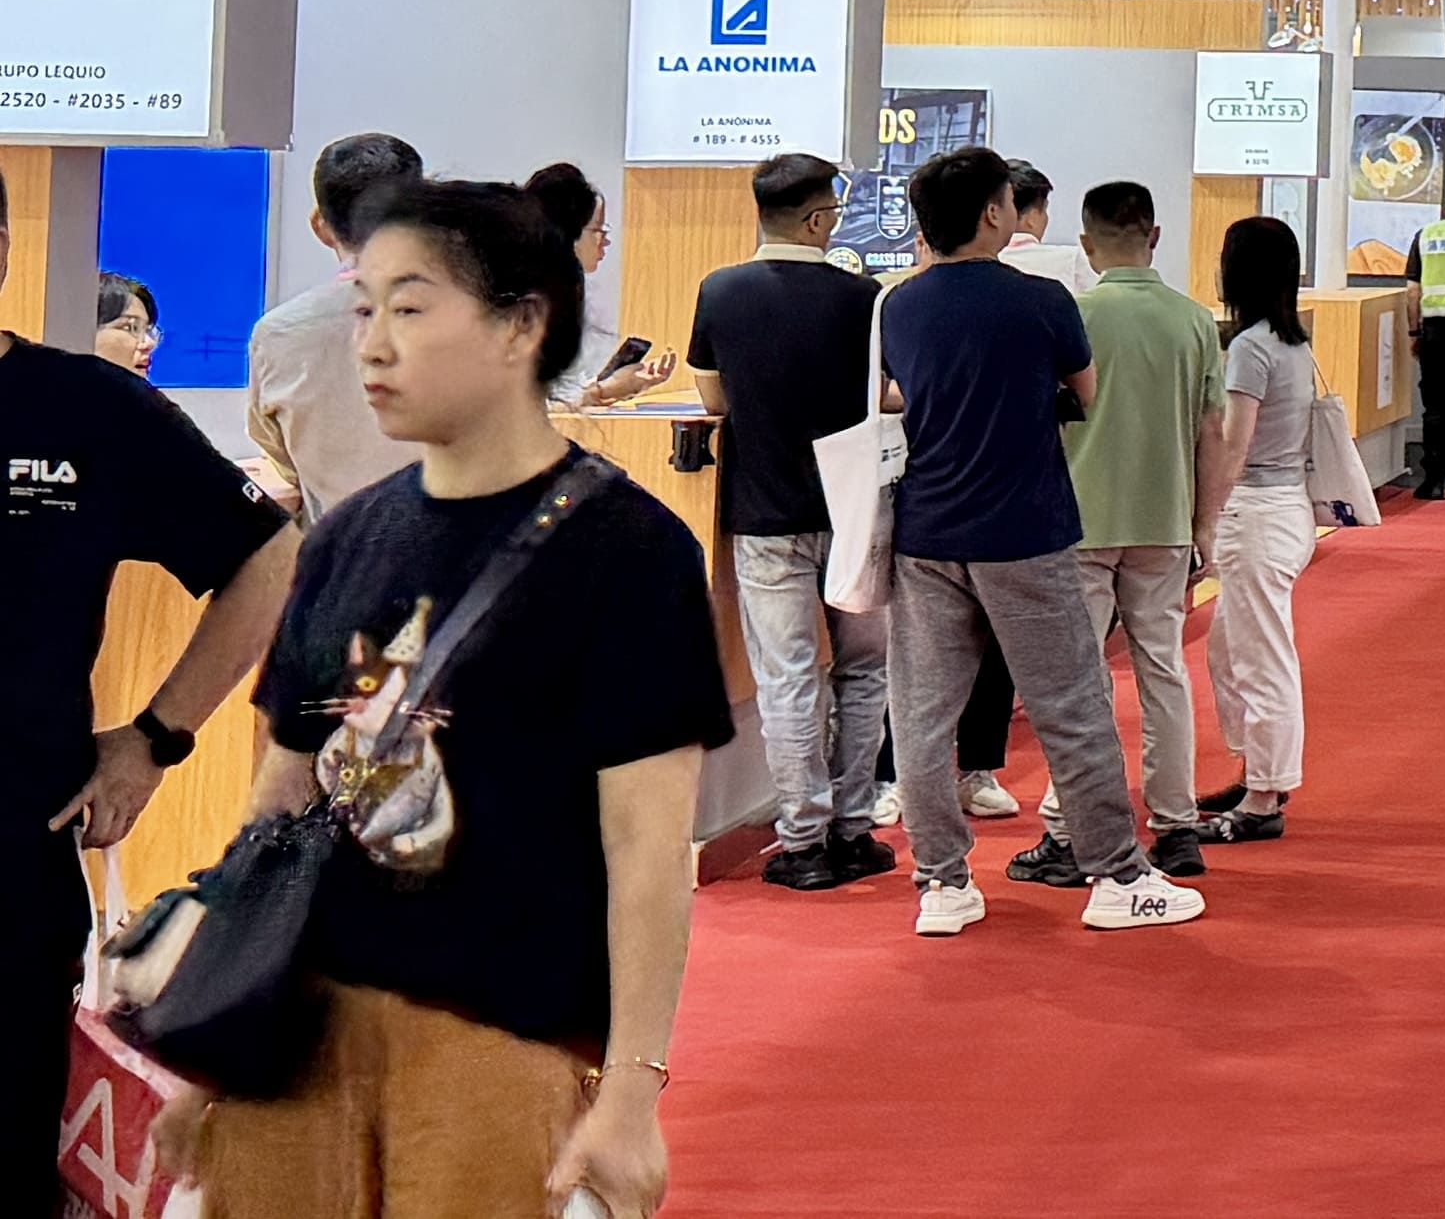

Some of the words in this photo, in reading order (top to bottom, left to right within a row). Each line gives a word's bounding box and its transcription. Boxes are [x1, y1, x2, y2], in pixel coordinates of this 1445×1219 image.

[44, 65, 106, 80] LEQUIO
[658, 56, 690, 72] LA
[696, 56, 817, 73] ANONIMA
[67, 93, 126, 110] #2035
[147, 93, 183, 110] #89
[9, 458, 78, 483] FILA
[1130, 894, 1168, 917] Lee
